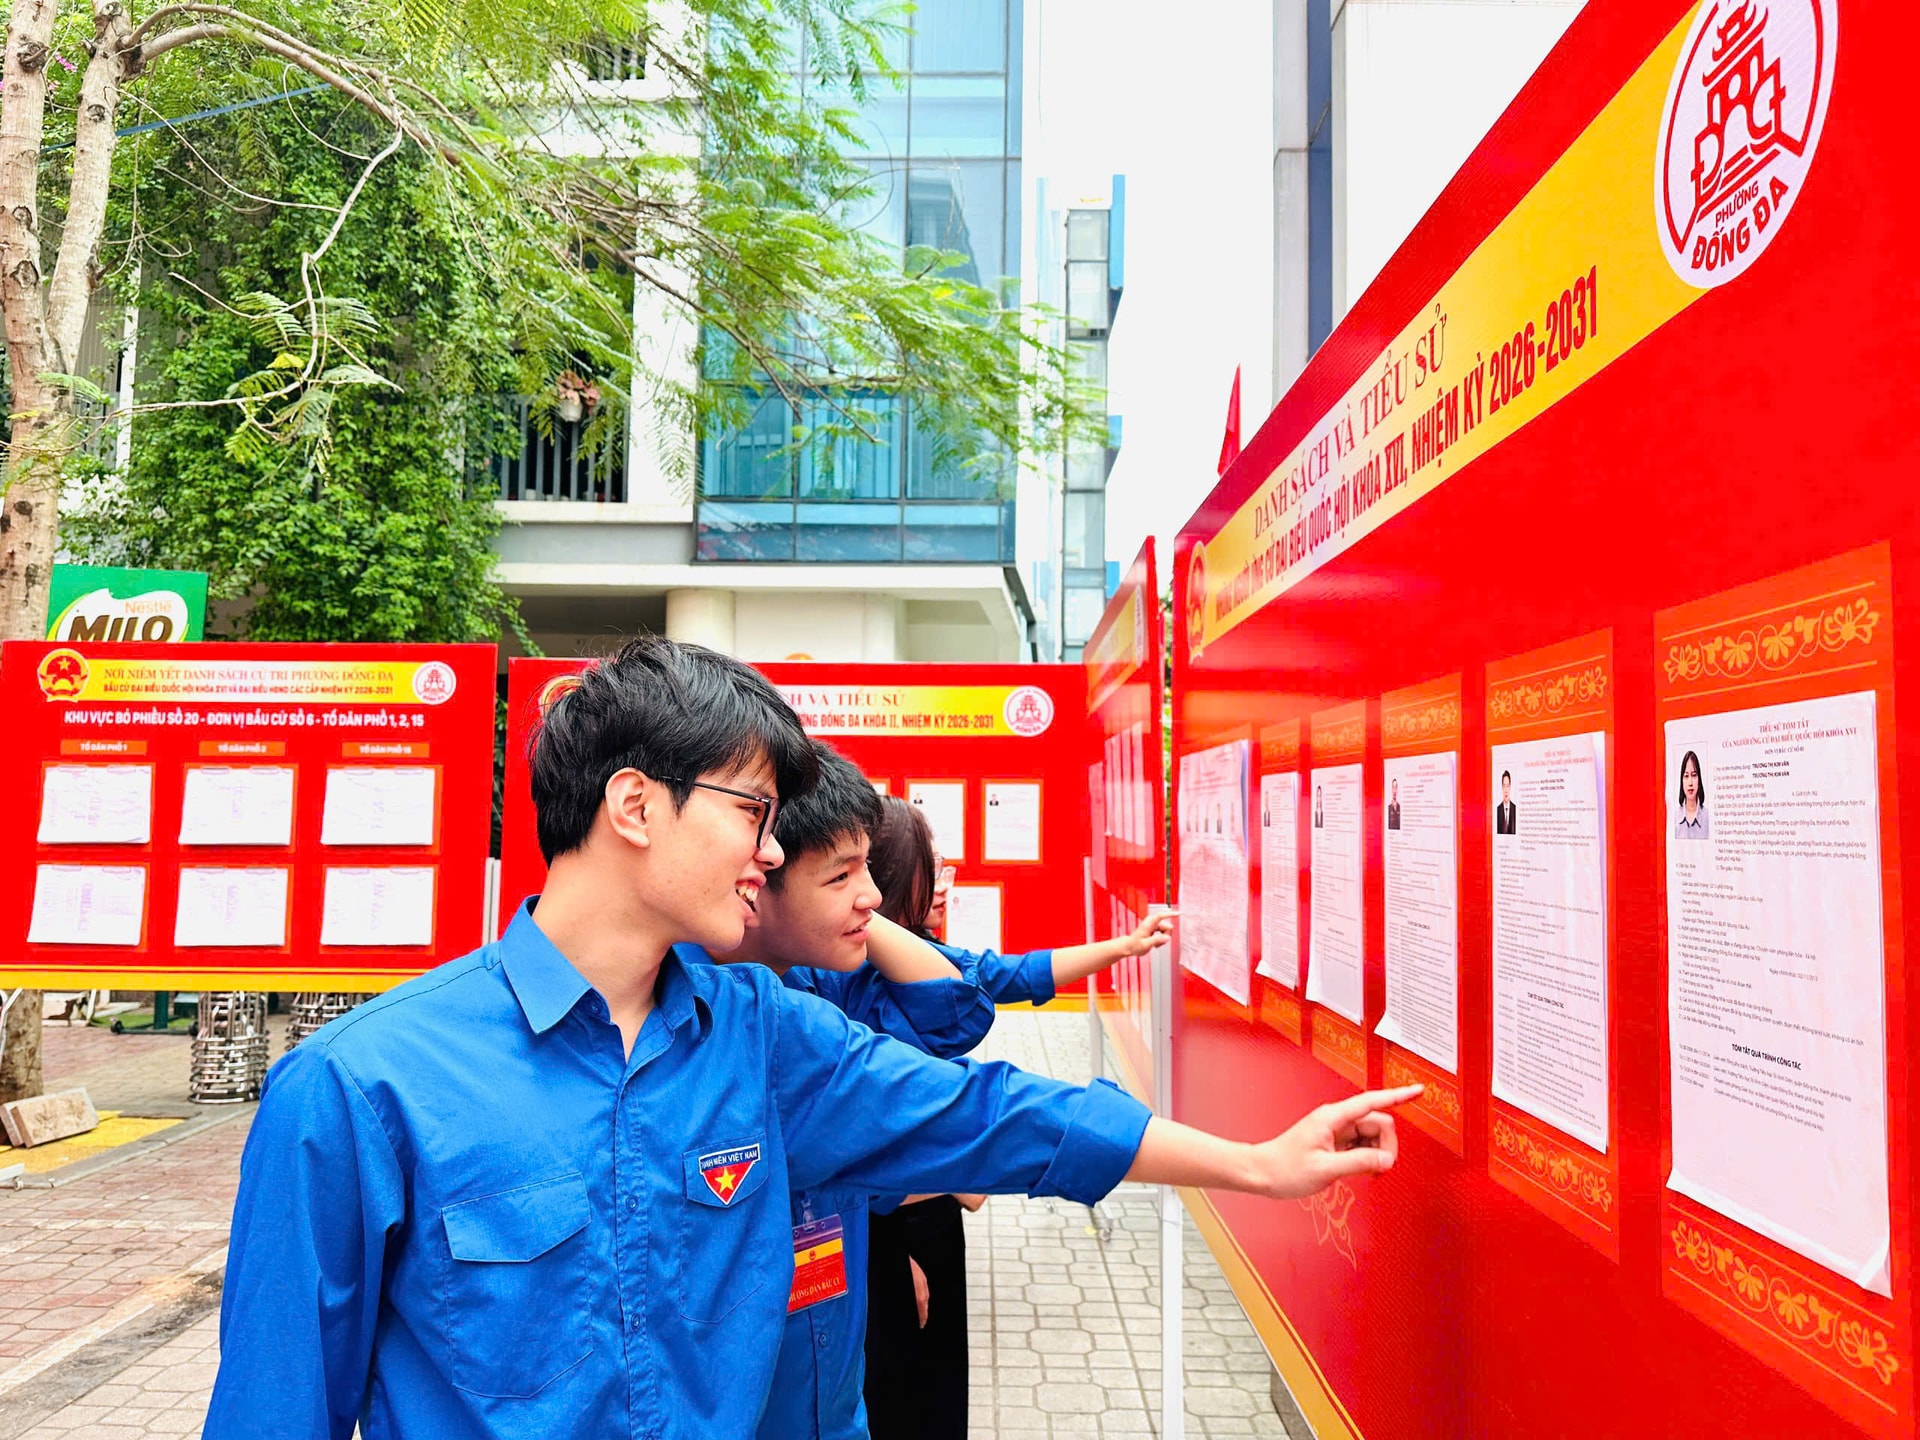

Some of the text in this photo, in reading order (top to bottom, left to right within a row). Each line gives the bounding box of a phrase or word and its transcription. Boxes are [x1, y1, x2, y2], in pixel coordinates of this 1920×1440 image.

[1715, 180, 1759, 228] PHƯỜNG
[1691, 175, 1789, 272] ĐỐNG ĐA
[1254, 302, 1447, 539] DANH SÁCH VÀ TIỂU SỬ
[1275, 532, 1288, 581] ĐẠI
[1289, 504, 1307, 568] BIỂU
[1309, 484, 1331, 555] QUỐC
[1334, 474, 1350, 538] HỘI
[1352, 449, 1381, 520] KHÓA
[1384, 432, 1408, 496] XVI,
[1412, 386, 1459, 476] NHIỆM
[1464, 352, 1485, 436] KỲ
[1489, 265, 1597, 416] 2026-2031
[104, 667, 124, 679] NƠI
[183, 669, 215, 680] DANH
[218, 667, 247, 680] SÁCH
[270, 670, 288, 680] TRI
[291, 667, 340, 680] PHƯỜNG
[342, 667, 375, 680] ĐỐNG
[378, 670, 393, 681] ĐA
[808, 690, 829, 706] VÀ
[836, 688, 878, 706] TIỂU
[882, 688, 906, 706] SỬ
[64, 711, 88, 724] KHU
[90, 711, 114, 727] VỰC
[115, 708, 132, 725] BỎ
[184, 712, 199, 725] 20
[207, 712, 232, 725] ĐƠN
[233, 712, 245, 728] VỊ
[306, 713, 315, 726] 6
[338, 710, 363, 726] DÂN
[388, 713, 397, 728] 1,
[399, 713, 410, 728] 2,
[410, 713, 424, 726] 15
[821, 708, 845, 727] ĐỐNG
[848, 714, 859, 727] ĐA
[863, 711, 887, 727] KHÓA
[902, 711, 931, 731] NHIỆM
[934, 711, 945, 728] KỲ
[947, 715, 994, 728] 2026-2031
[1845, 727, 1857, 736] XVI
[728, 1152, 744, 1163] VIỆT
[745, 1149, 758, 1159] NAM
